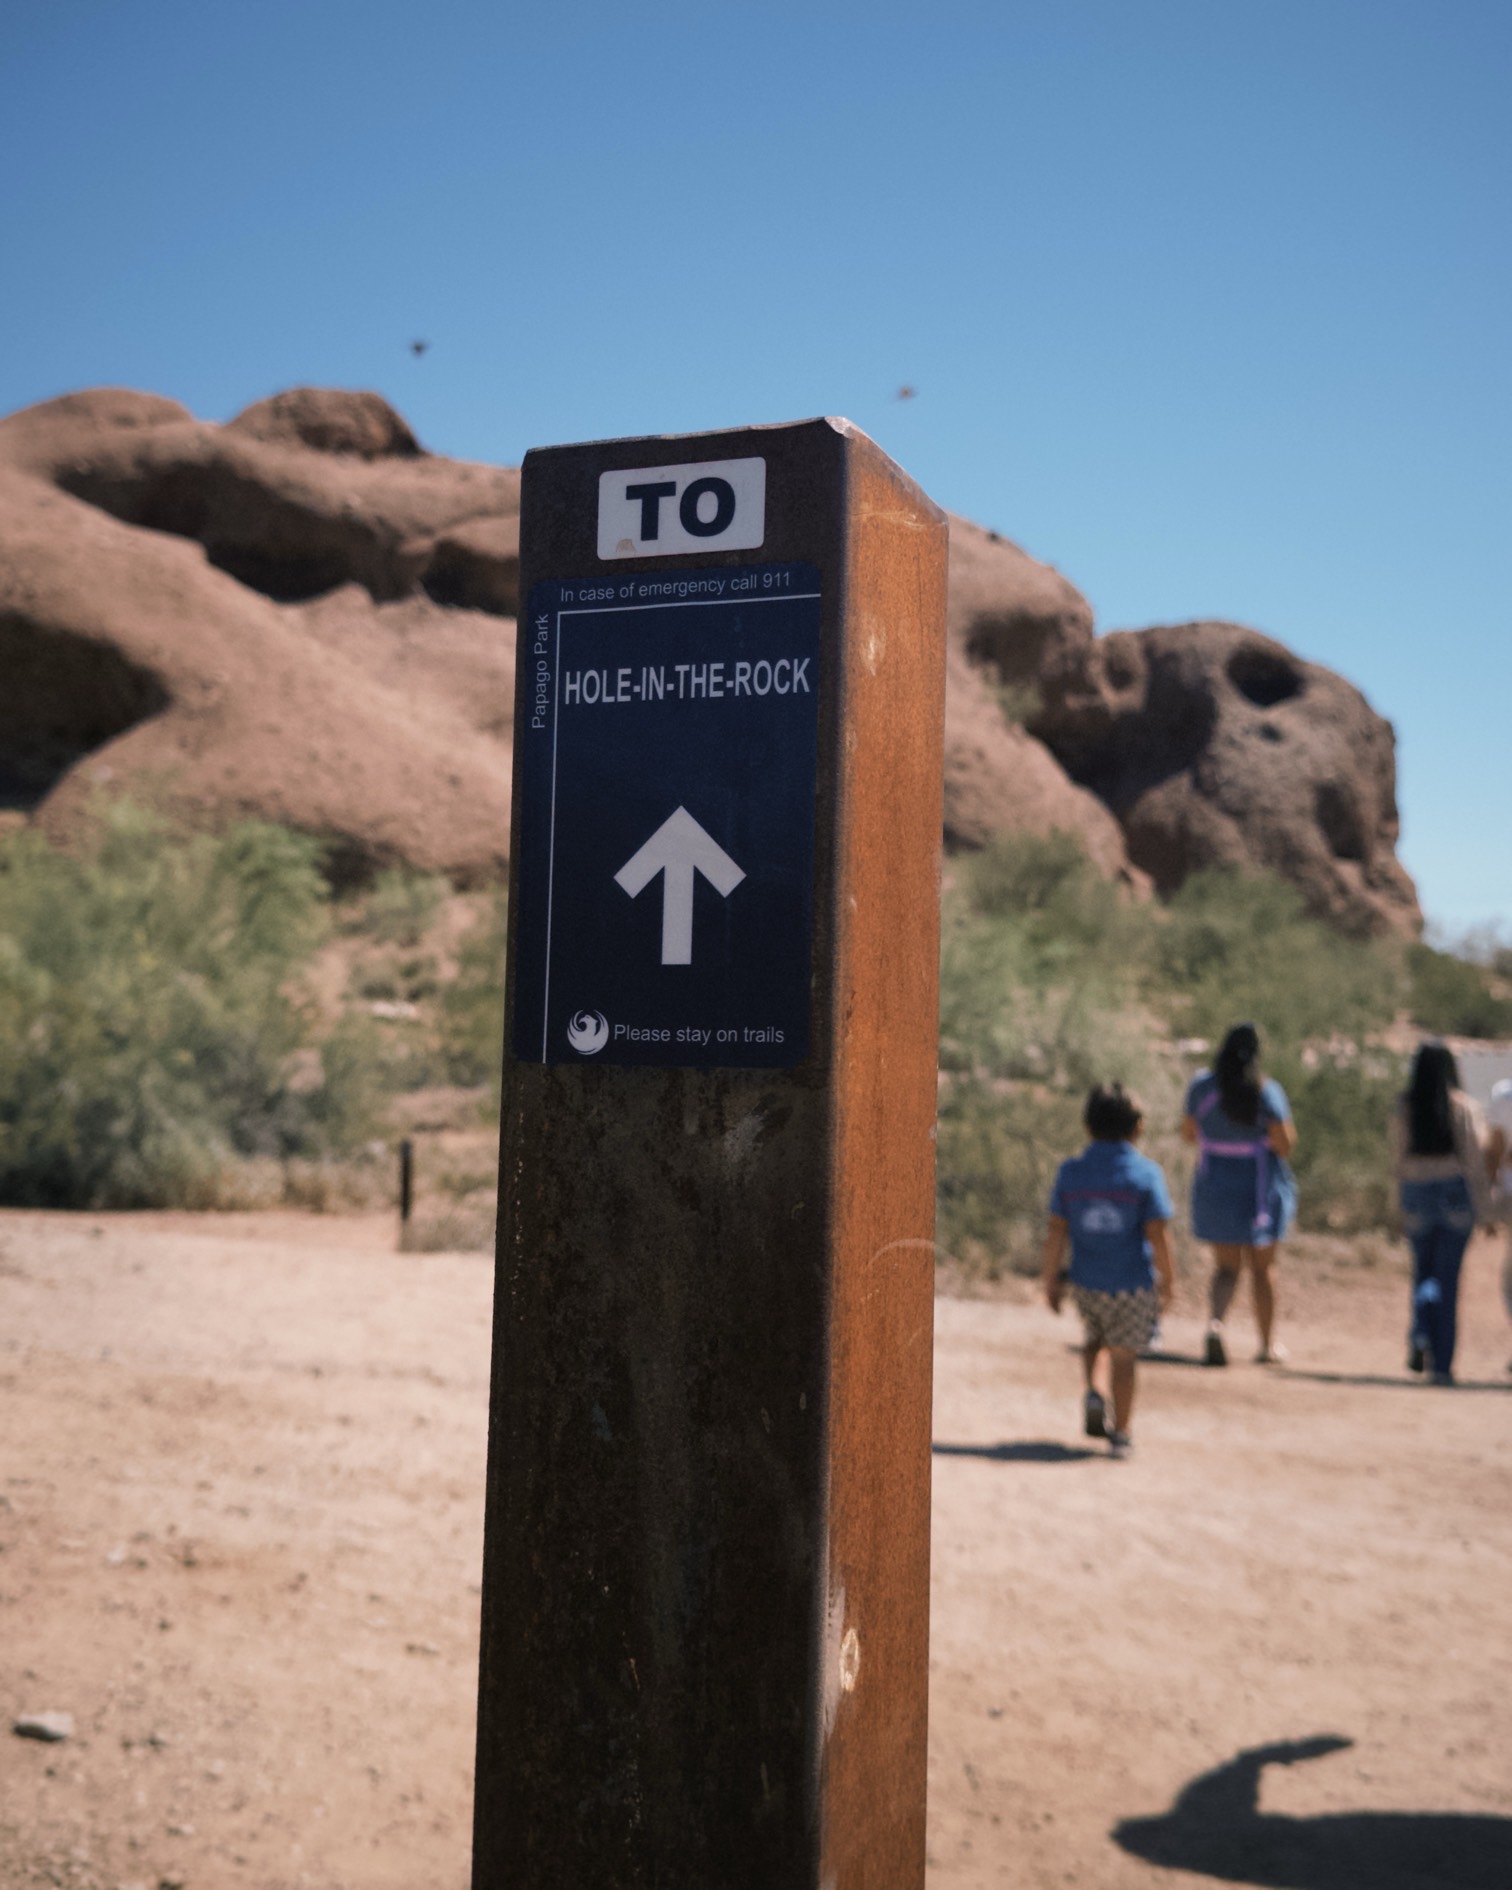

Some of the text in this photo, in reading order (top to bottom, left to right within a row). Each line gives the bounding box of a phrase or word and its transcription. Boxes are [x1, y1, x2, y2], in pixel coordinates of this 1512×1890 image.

[626, 476, 736, 541] TO
[560, 572, 790, 602] In case of emergency call 911
[532, 614, 550, 728] Papago Park
[565, 658, 810, 704] HOLE-IN-THE-ROCK
[614, 1024, 785, 1045] Please stay on trails
